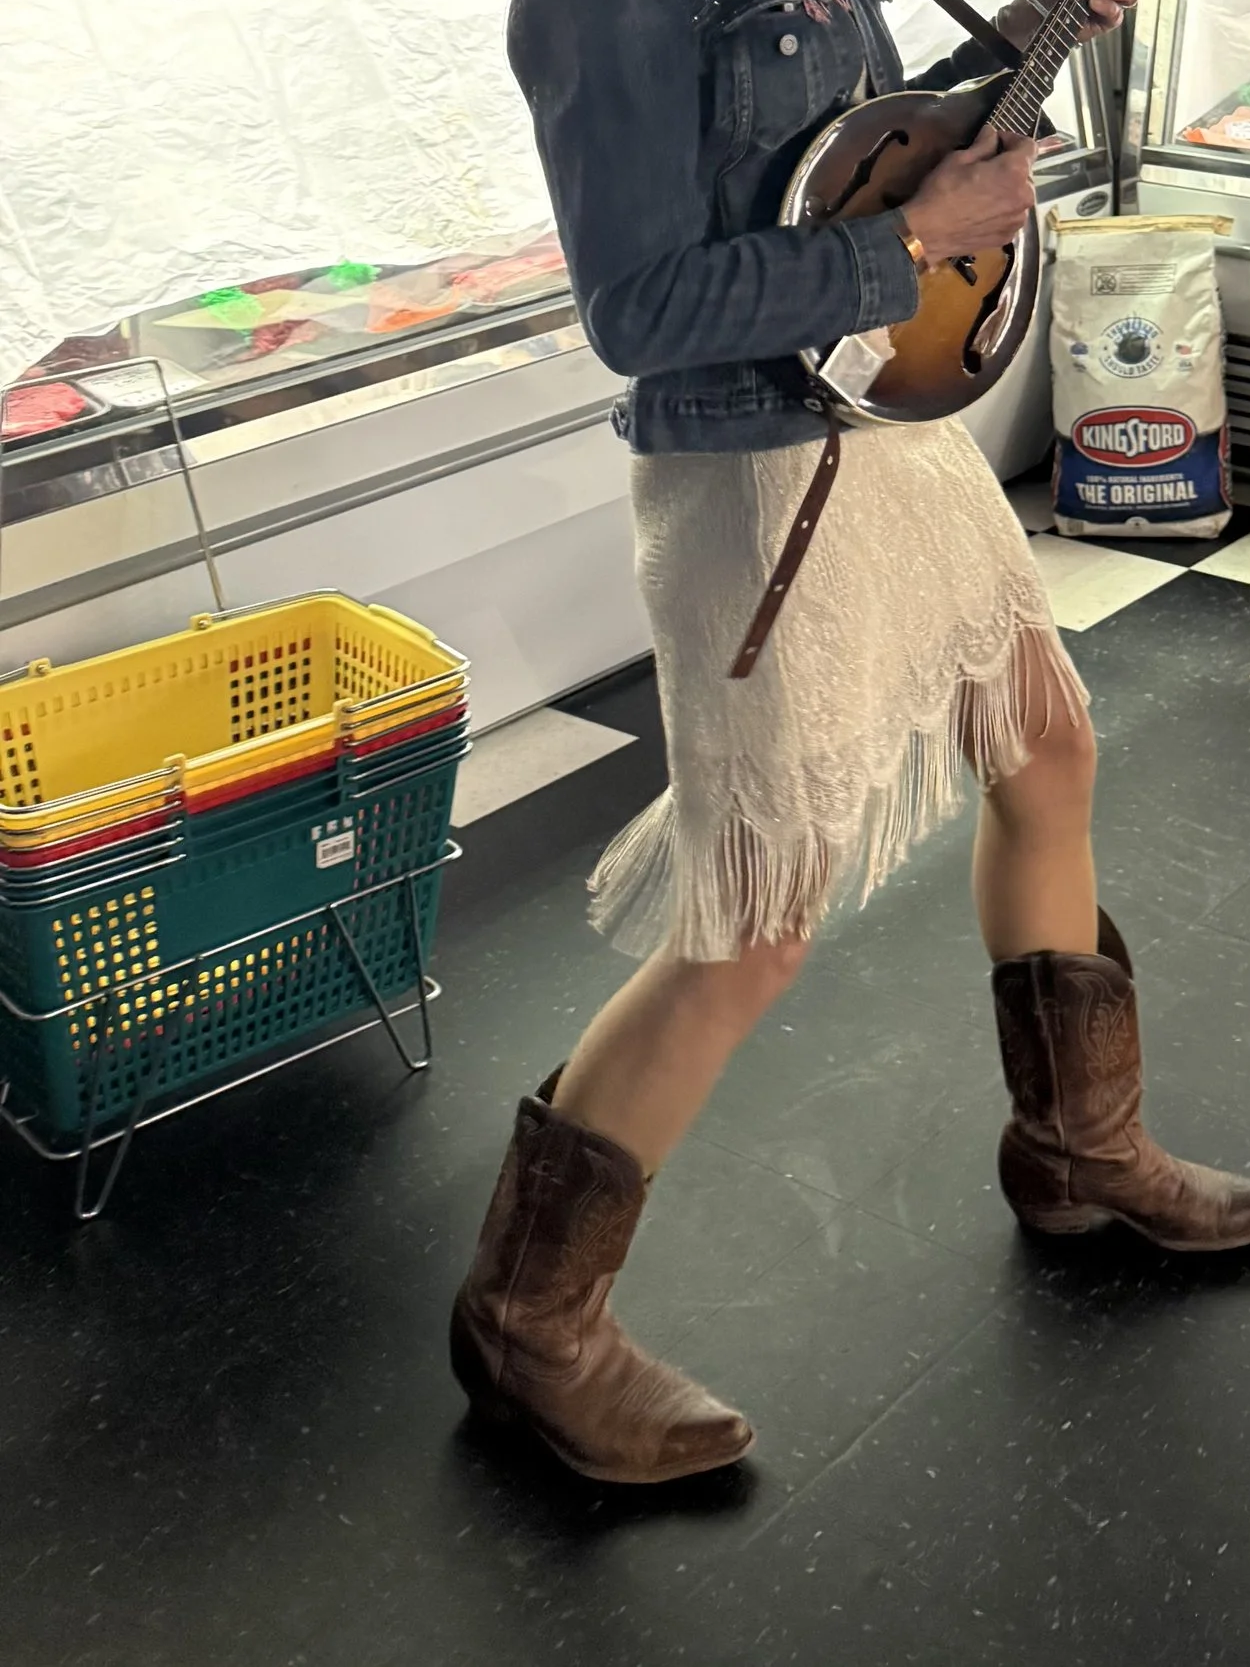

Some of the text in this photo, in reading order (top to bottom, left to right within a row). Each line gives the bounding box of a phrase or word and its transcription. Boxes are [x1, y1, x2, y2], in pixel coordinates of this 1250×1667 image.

[1081, 417, 1186, 458] KINGSFORD
[1074, 480, 1199, 505] THE ORIGINAL
